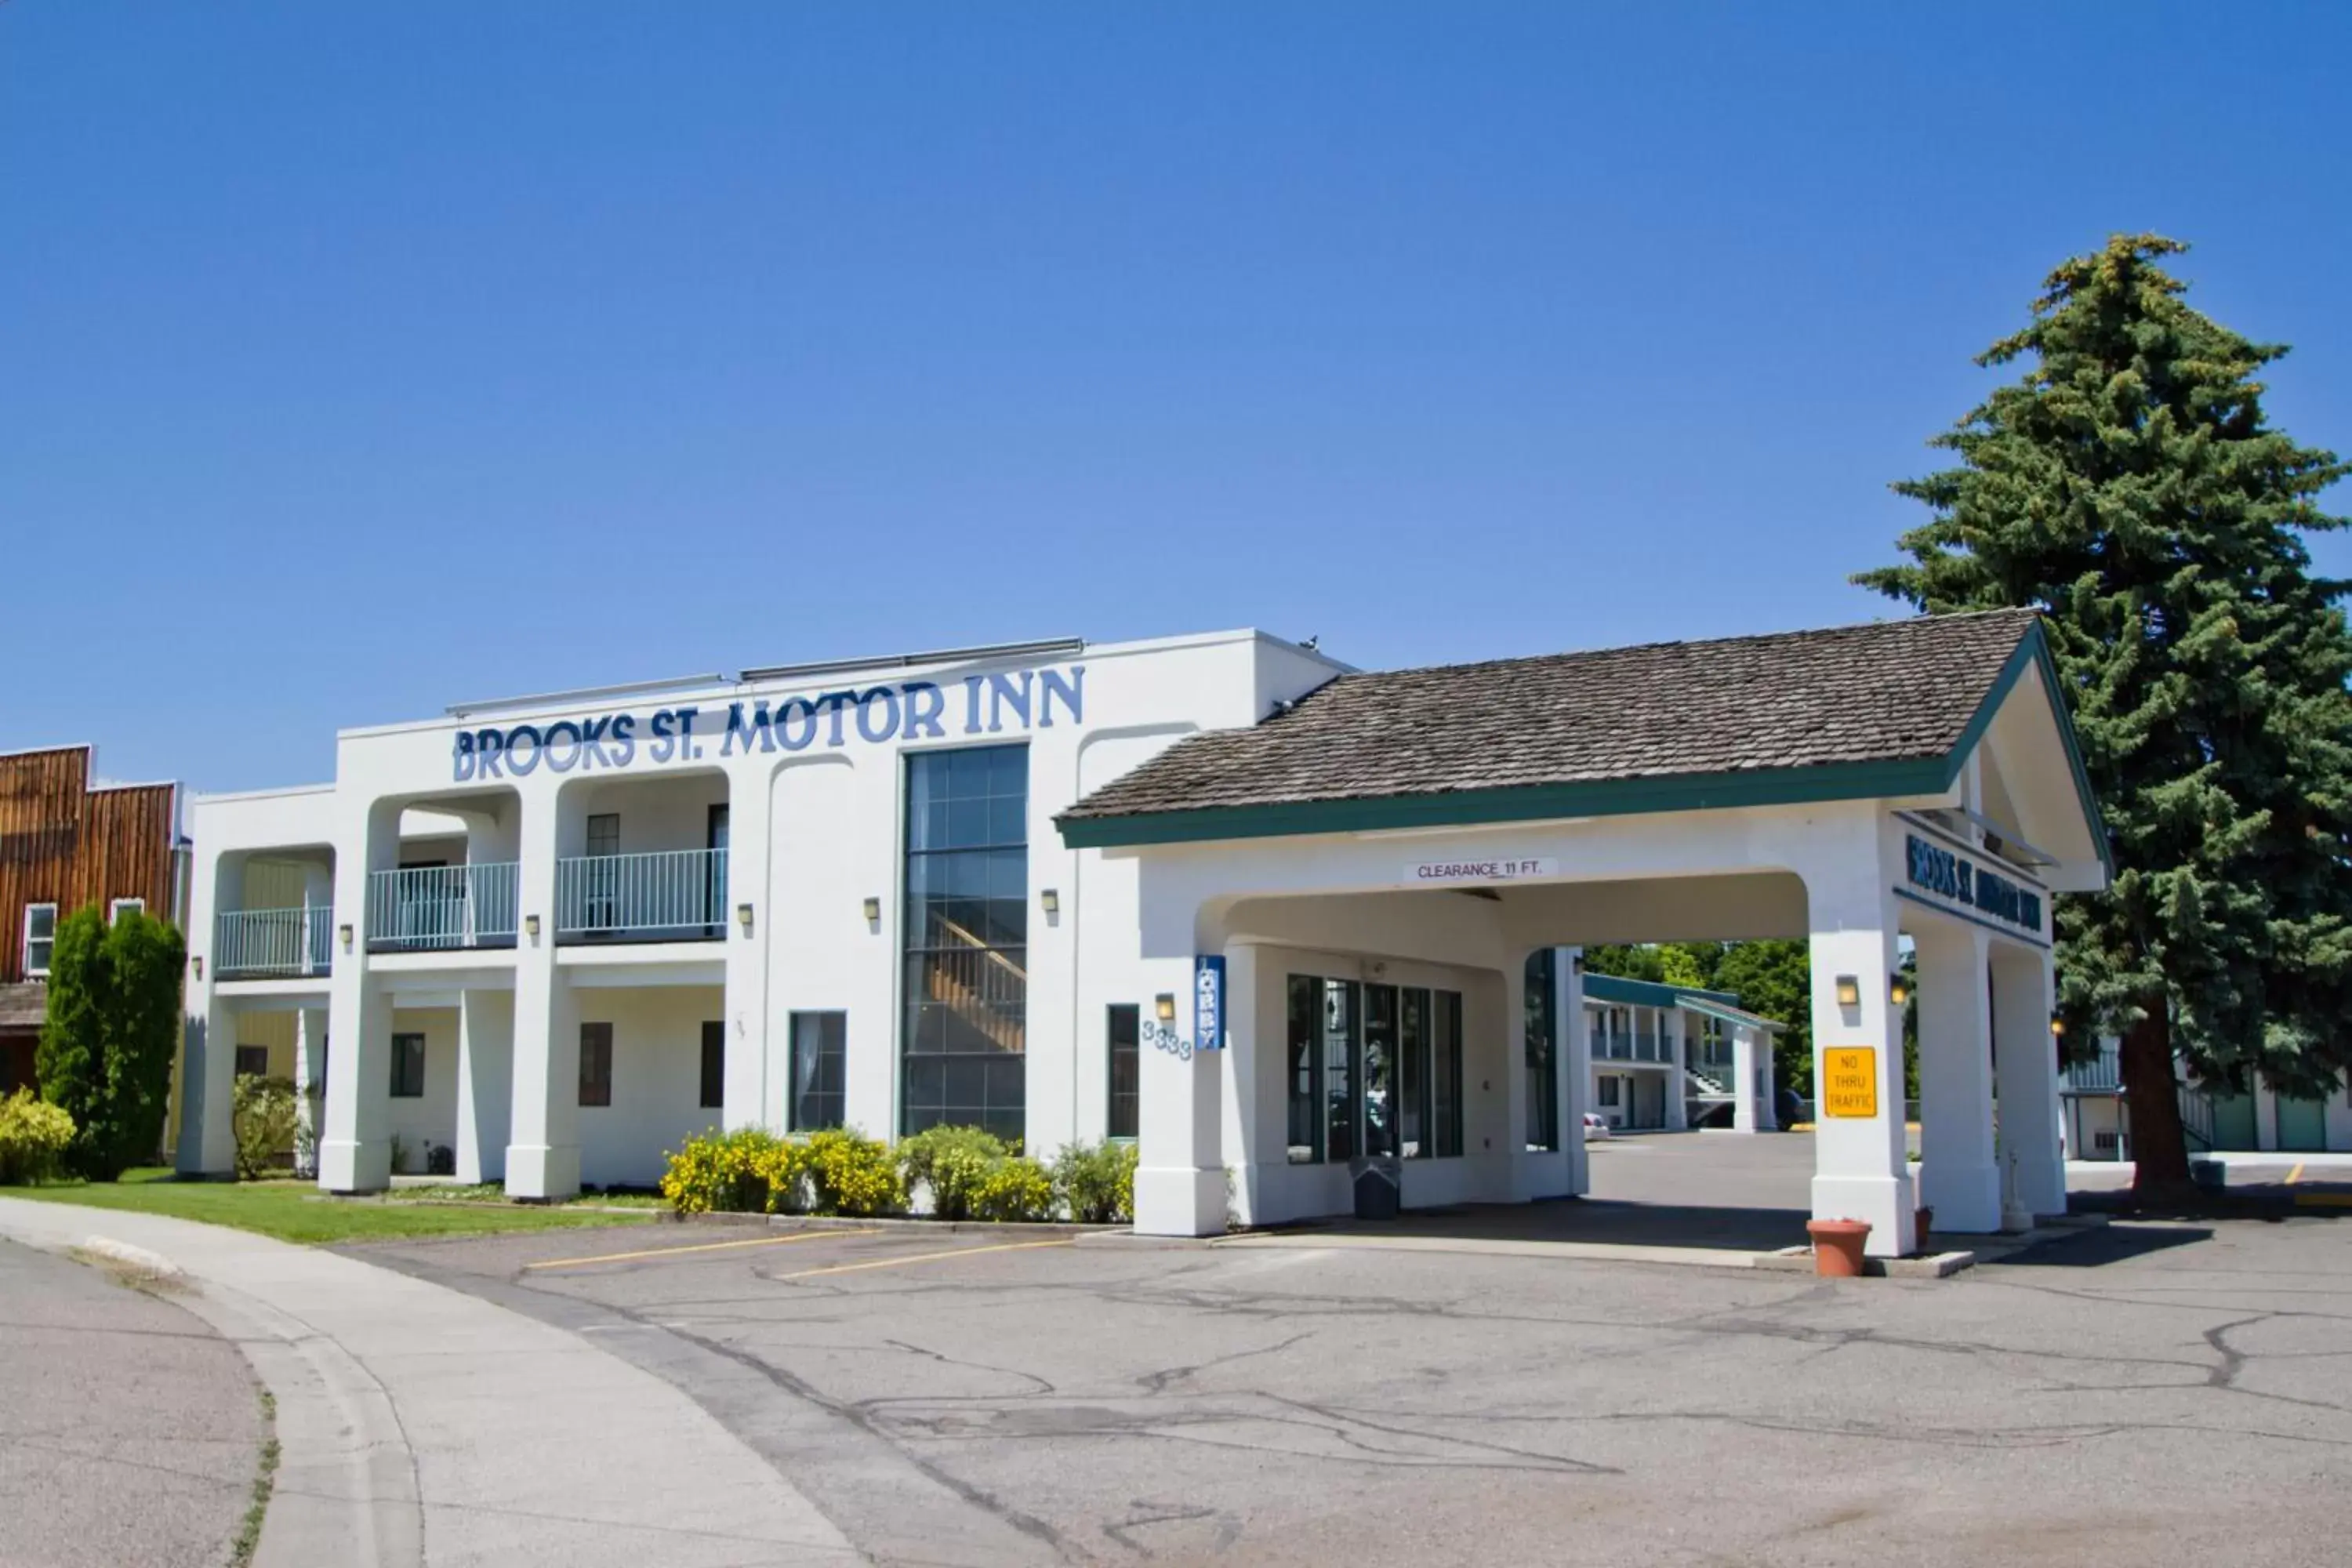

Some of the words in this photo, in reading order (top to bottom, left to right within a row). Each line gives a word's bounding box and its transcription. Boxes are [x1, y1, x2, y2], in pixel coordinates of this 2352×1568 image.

[452, 713, 636, 782] BROOKS
[649, 706, 704, 764] ST.
[719, 681, 946, 757] MOTOR
[963, 666, 1086, 735] INN
[1417, 862, 1498, 879] CLEARANCE
[1505, 862, 1516, 874] 11
[1521, 860, 1543, 875] FT.
[1142, 1020, 1192, 1062] 3333
[1841, 1054, 1858, 1069] NO
[1835, 1074, 1866, 1089] THRU
[1829, 1093, 1872, 1110] TRAFFIC
